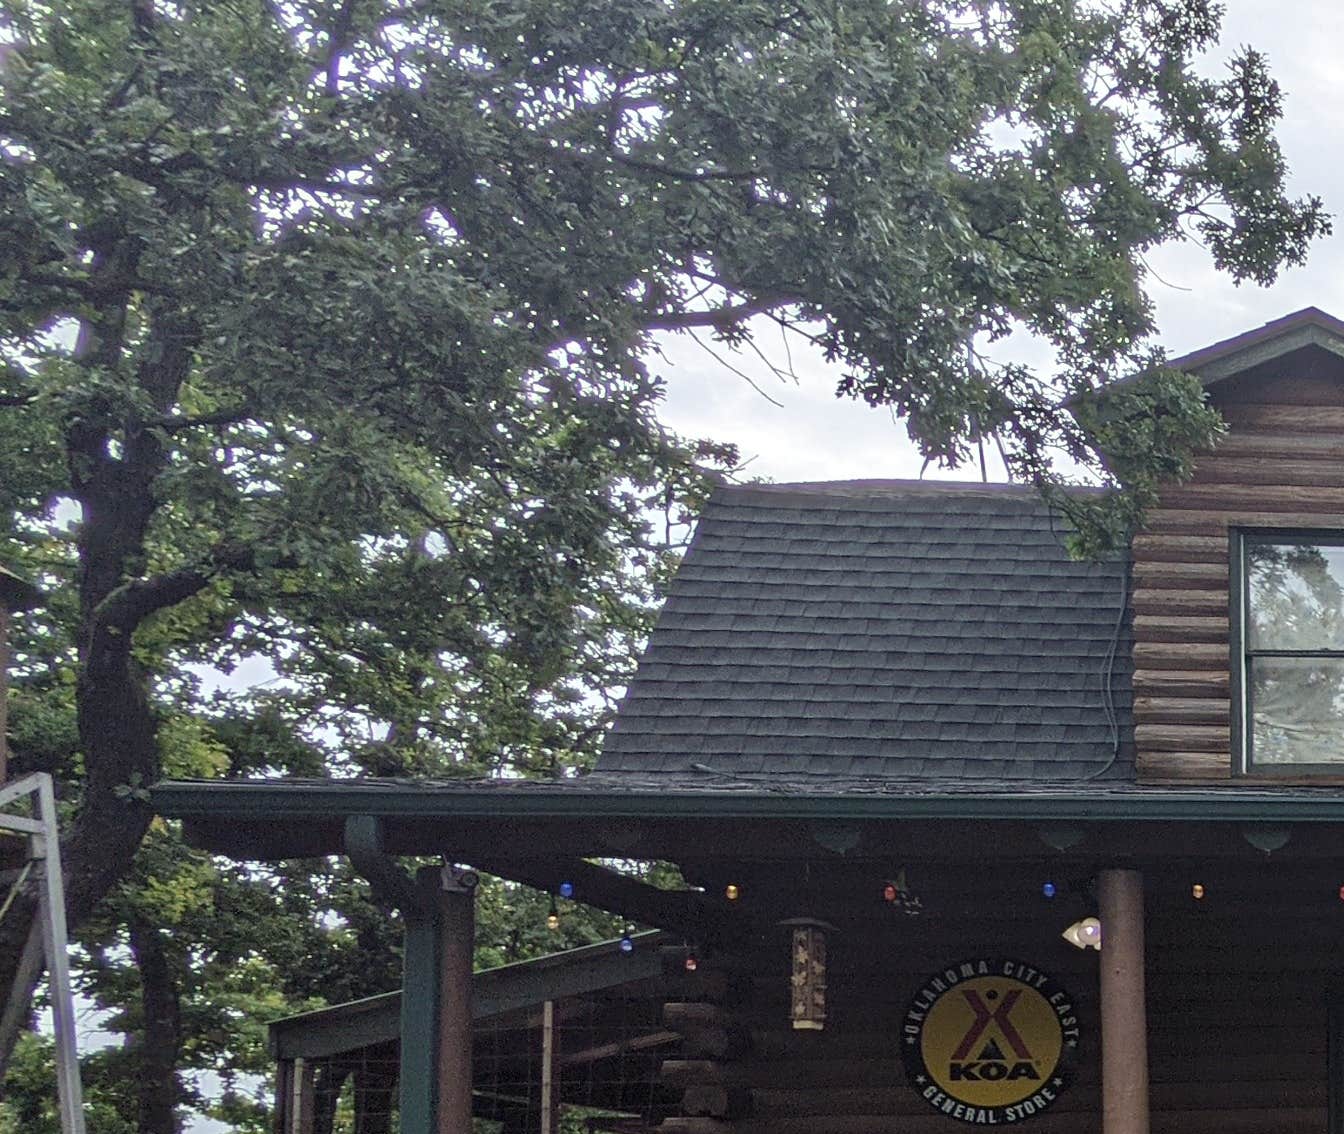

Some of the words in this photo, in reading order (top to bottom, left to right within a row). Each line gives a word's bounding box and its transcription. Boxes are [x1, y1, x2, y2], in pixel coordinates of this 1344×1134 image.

[904, 960, 988, 1035] OKLAHOMA
[1003, 961, 1048, 988] CITY
[1050, 992, 1079, 1036] EAST
[949, 1062, 1041, 1081] KOA
[922, 1085, 997, 1123] GENERAL
[1006, 1087, 1056, 1122] STORE
